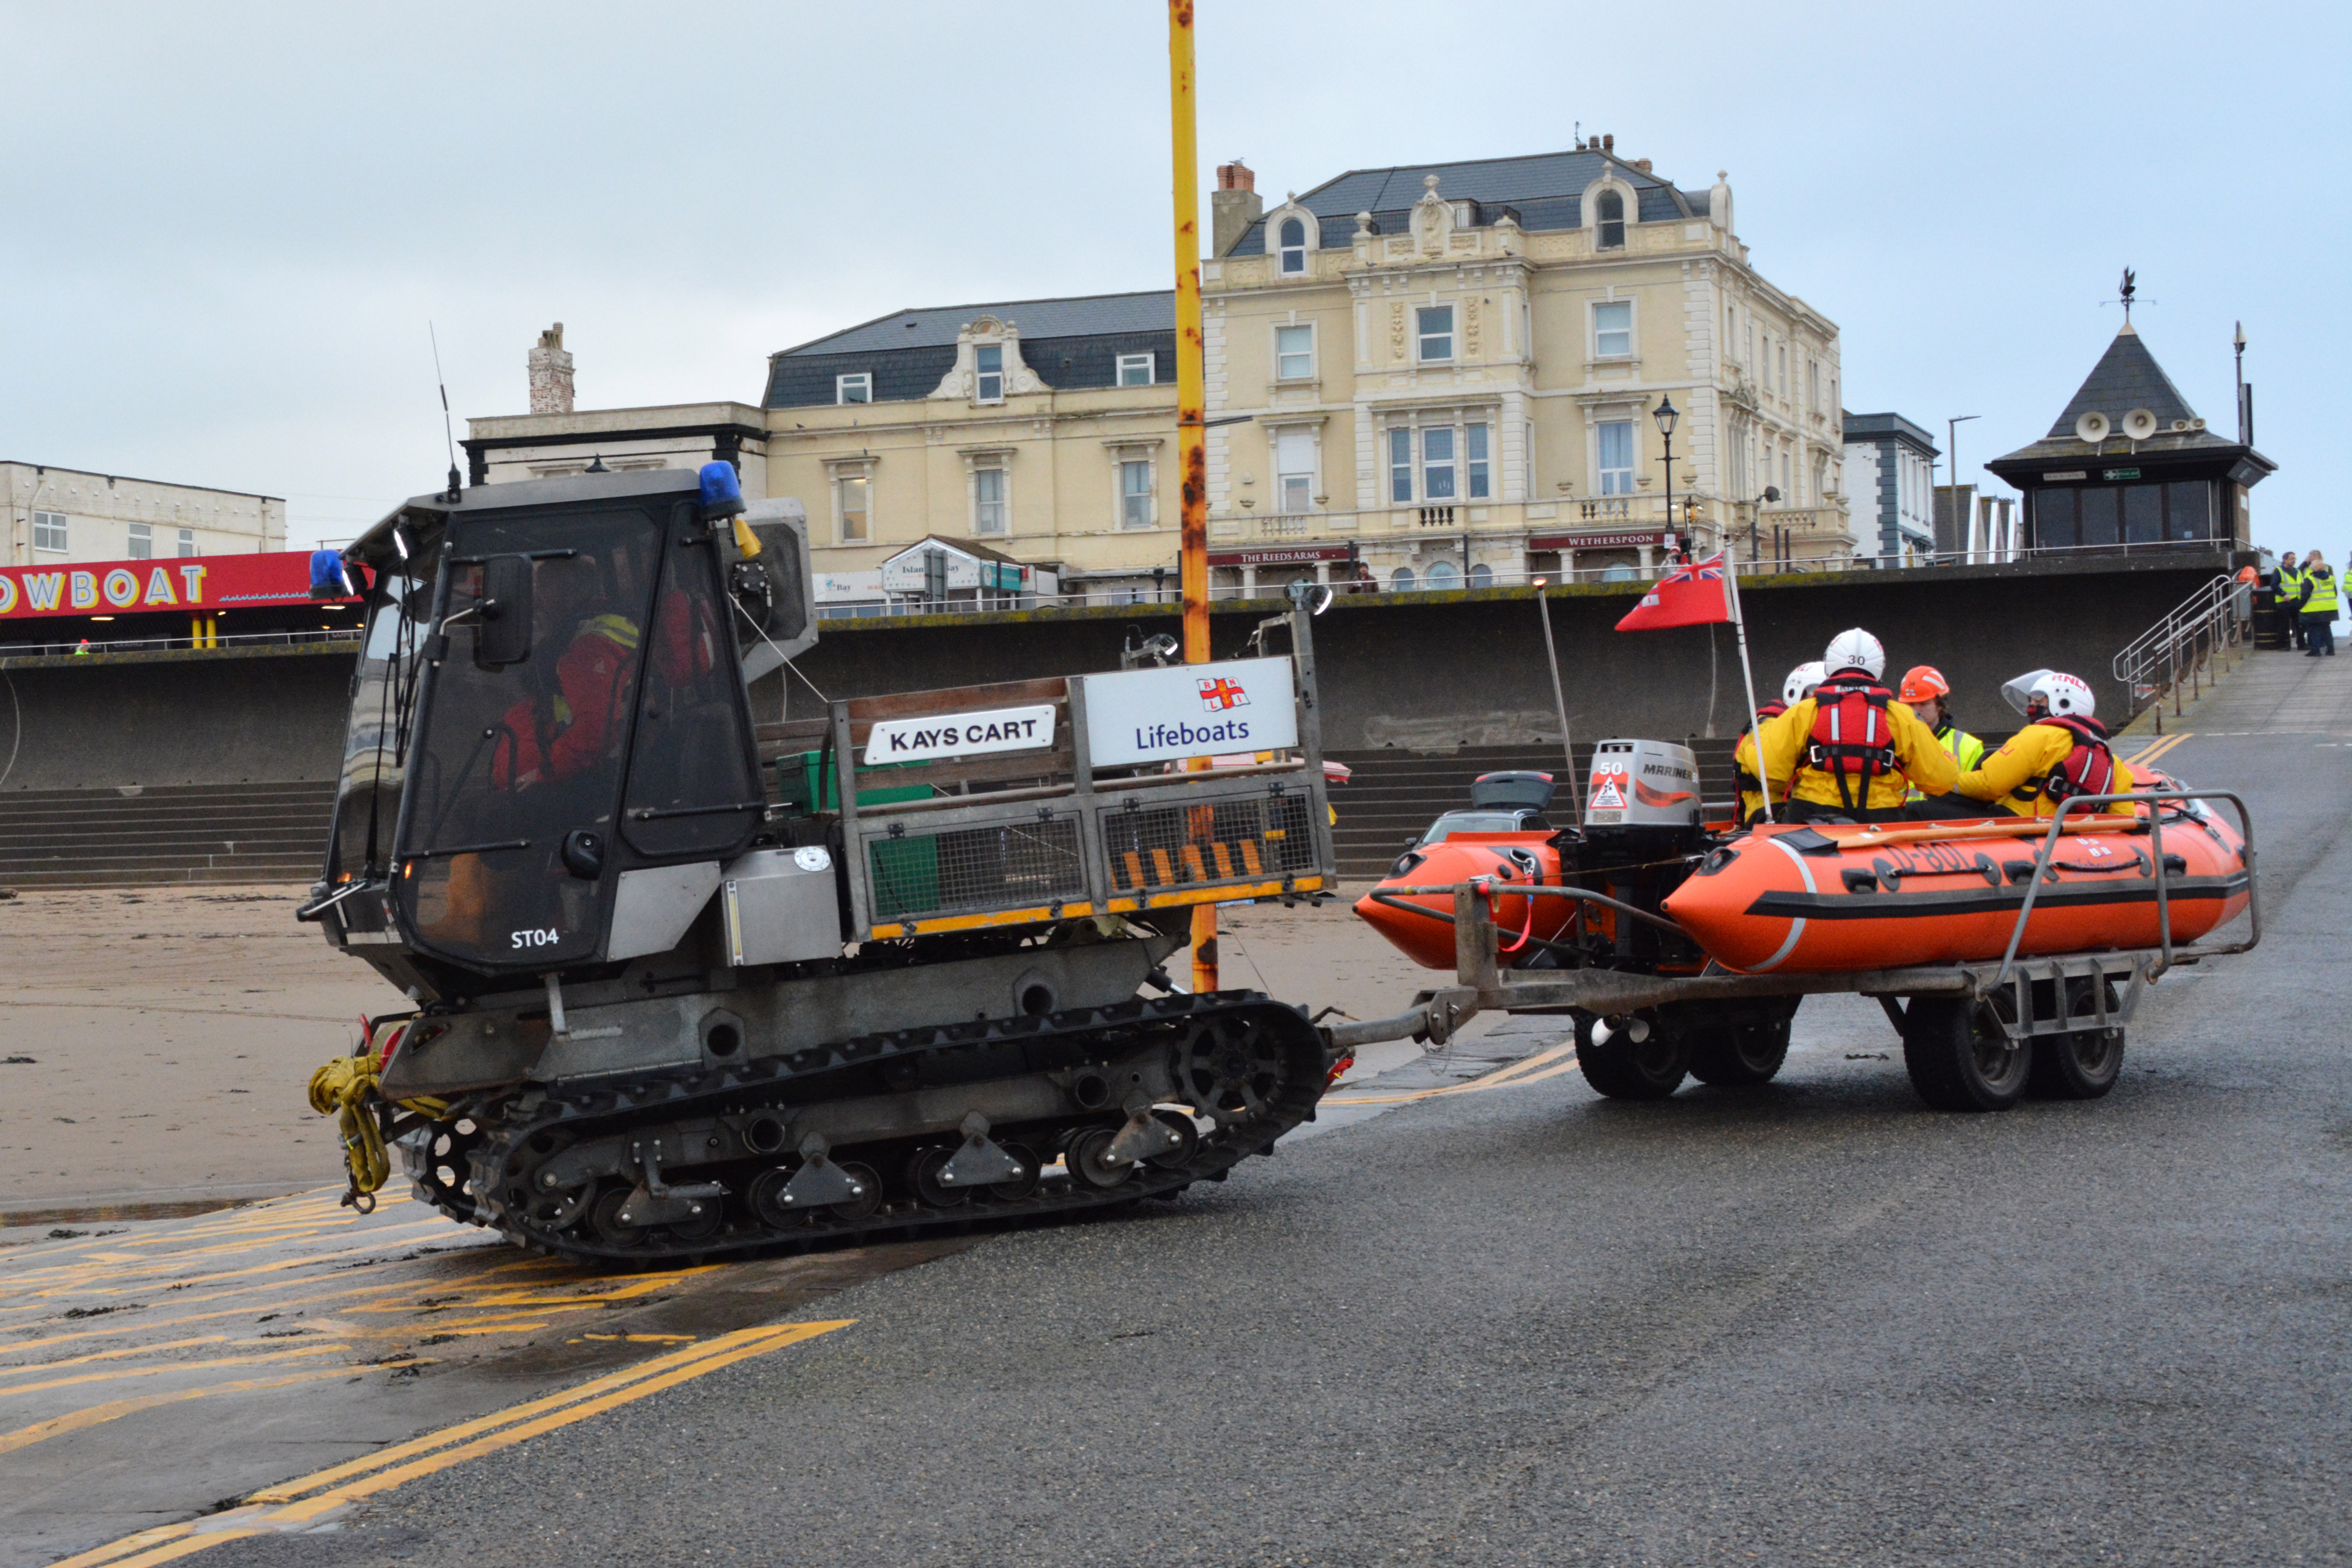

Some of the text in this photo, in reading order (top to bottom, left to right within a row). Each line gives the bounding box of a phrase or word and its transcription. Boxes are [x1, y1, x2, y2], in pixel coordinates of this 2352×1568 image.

[1568, 535, 1653, 545] WETHERSPOON
[1241, 551, 1320, 563] THE REEDS ARMS
[837, 583, 851, 592] Bay
[1847, 655, 1865, 666] 30
[2052, 675, 2087, 691] RNLI
[891, 719, 1037, 751] KAYS CART
[1136, 720, 1249, 750] Lifeboats
[1599, 762, 1623, 775] 50
[1643, 764, 1692, 781] MARINER
[511, 927, 559, 949] ST04
